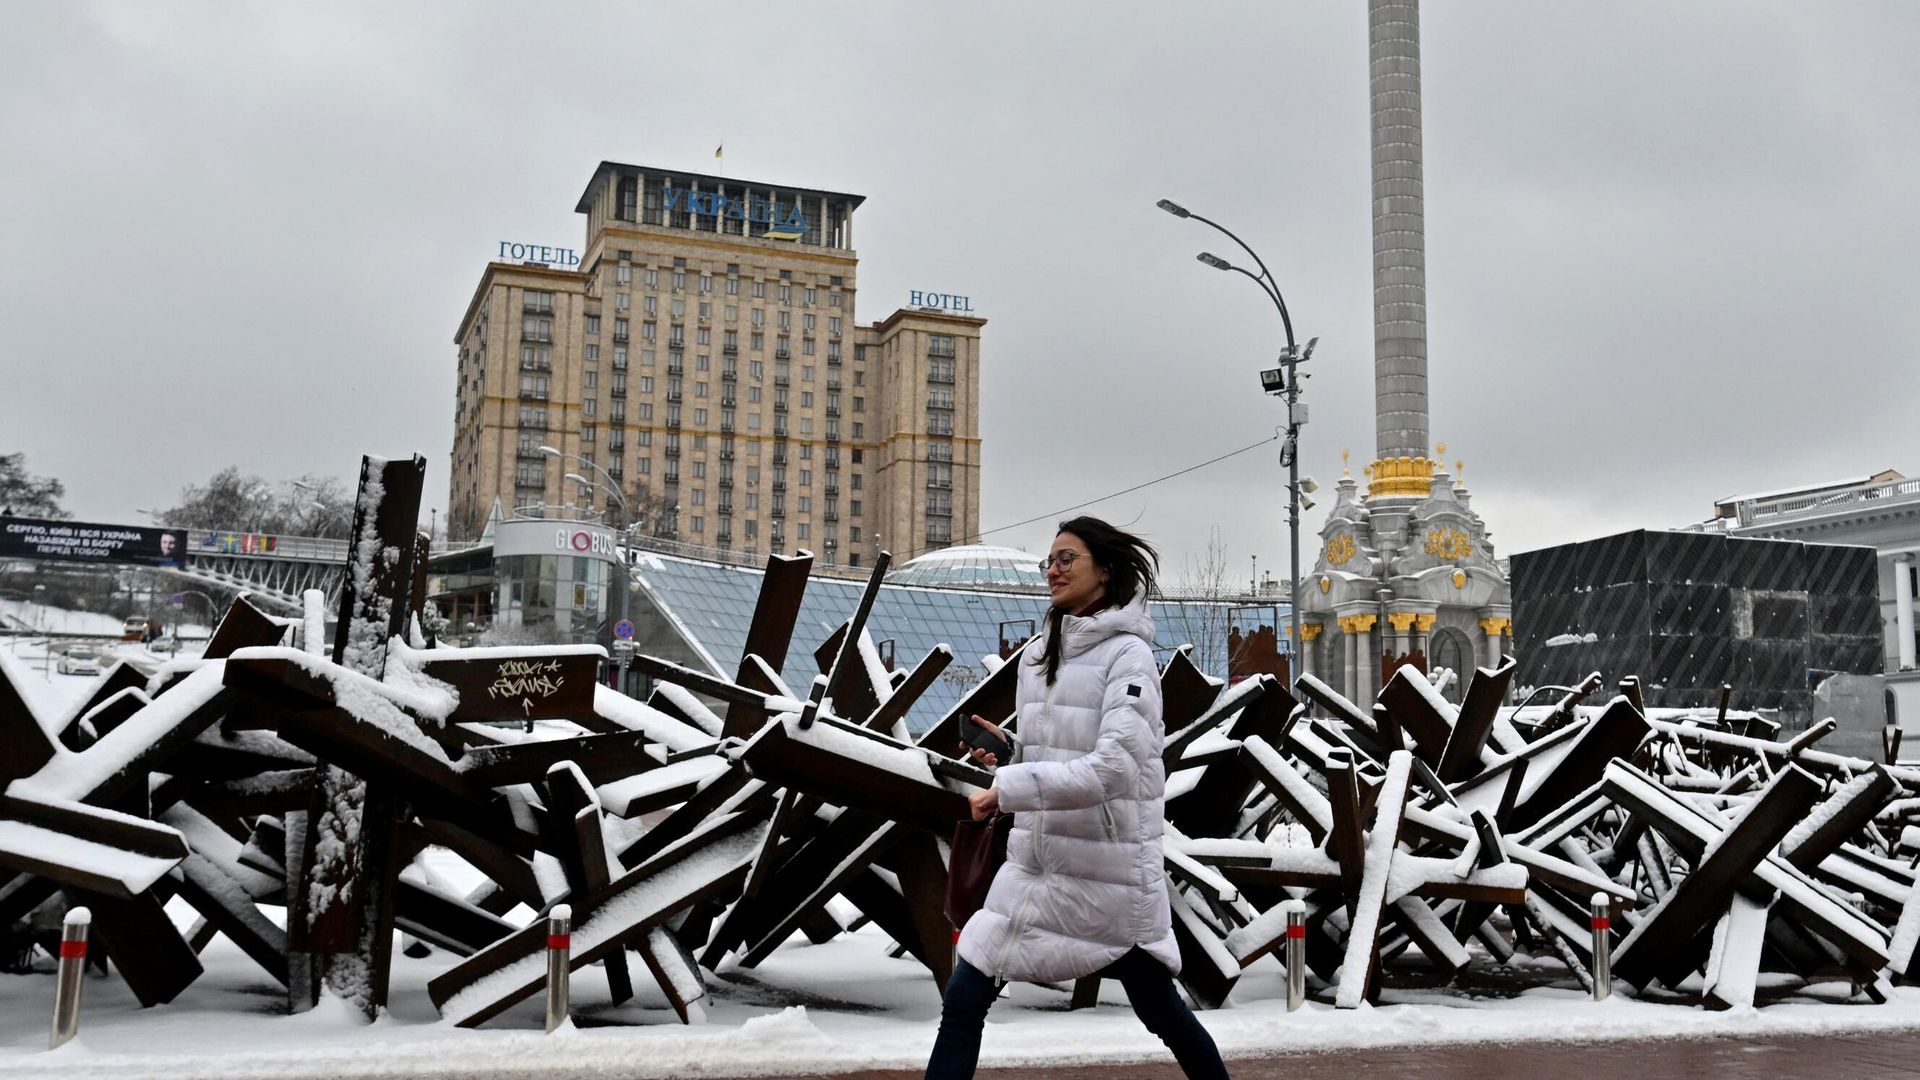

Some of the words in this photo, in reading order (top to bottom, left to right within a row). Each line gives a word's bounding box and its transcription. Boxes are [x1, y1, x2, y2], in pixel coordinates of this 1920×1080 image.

[661, 186, 808, 226] УКРАЇНА
[499, 241, 579, 265] ГОТЕЛЬ
[910, 290, 974, 311] HOTEL
[24, 535, 81, 546] НАЗАВЖДИ
[82, 539, 90, 547] В
[91, 540, 124, 549] БОРГУ
[79, 529, 100, 538] ВСЯ
[101, 530, 141, 541] УКРАЇНА
[555, 530, 612, 555] GLOBUS
[37, 545, 71, 555] ПЕРЕД
[72, 547, 110, 557] ТОБОЮ
